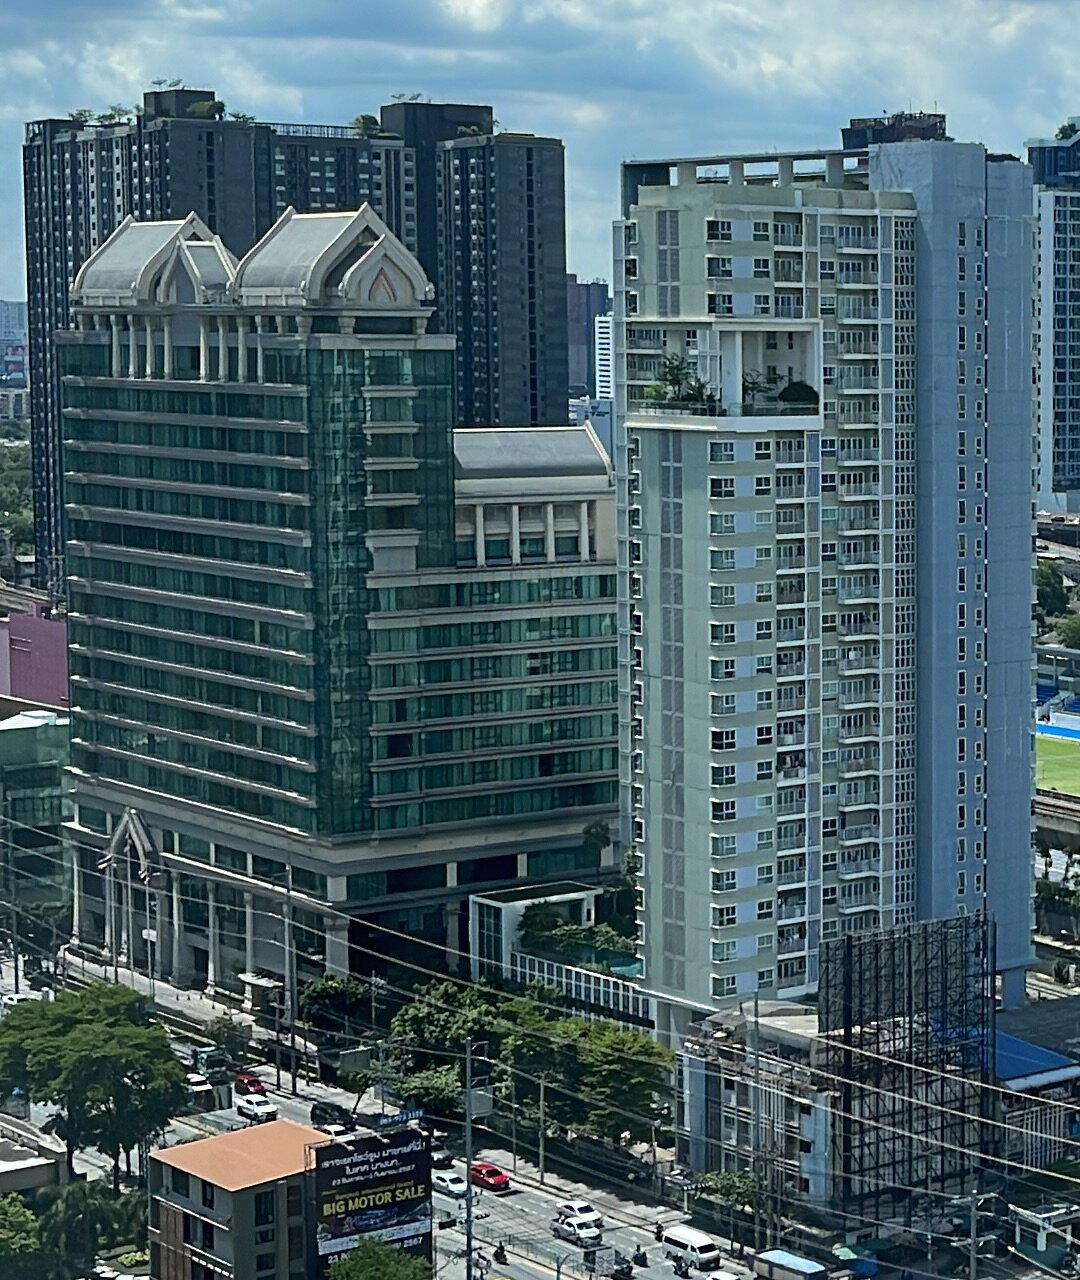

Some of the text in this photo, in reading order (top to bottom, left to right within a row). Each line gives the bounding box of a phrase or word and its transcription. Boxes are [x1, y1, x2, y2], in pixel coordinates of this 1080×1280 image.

[323, 1184, 425, 1217] BIG MOTOR SALE
